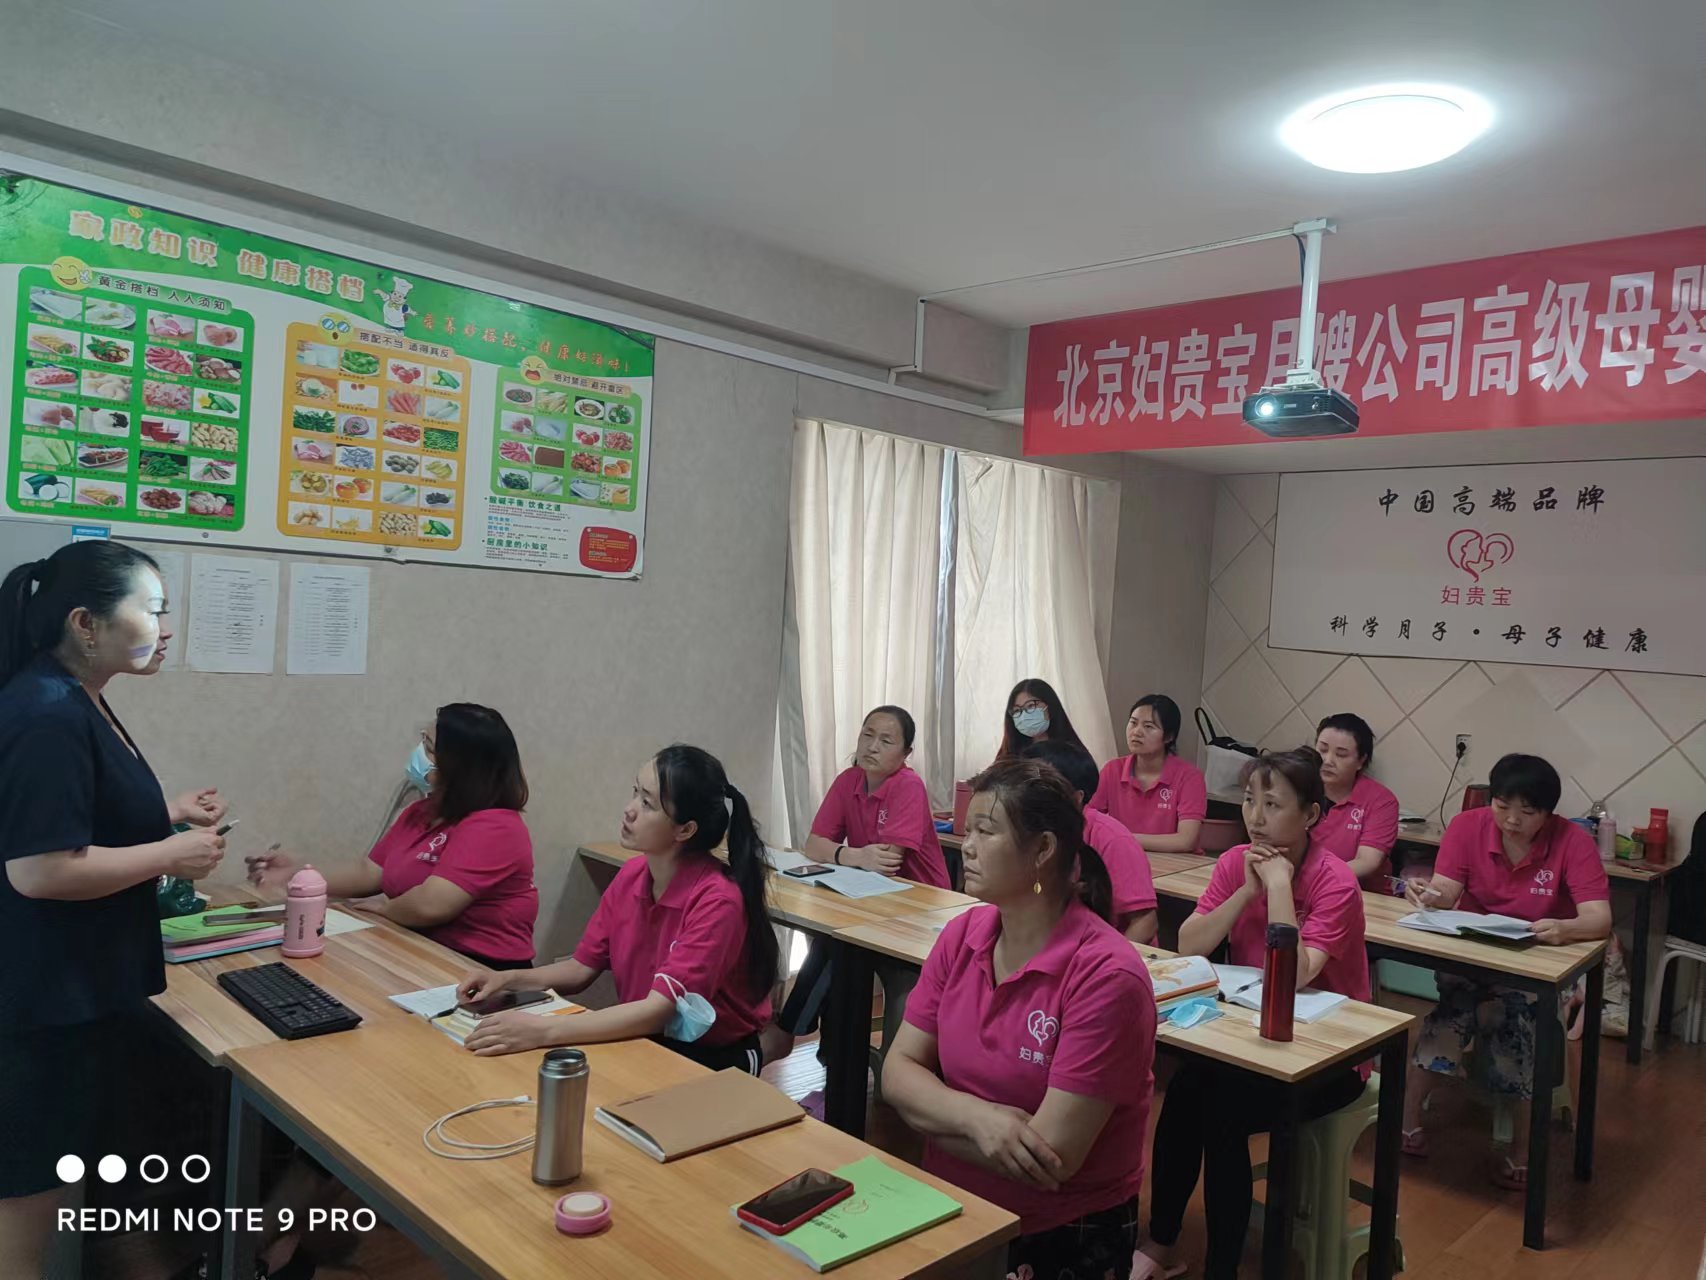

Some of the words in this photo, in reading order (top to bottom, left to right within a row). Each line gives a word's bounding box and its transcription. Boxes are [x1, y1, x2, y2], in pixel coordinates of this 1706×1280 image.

[69, 209, 218, 268] 家政知识
[236, 247, 366, 303] 健康搭档
[98, 275, 159, 298] 黄金搭档
[168, 290, 226, 312] 人人须知
[359, 332, 403, 349] 搭配不当
[408, 343, 449, 358] 适得其反
[528, 501, 561, 512] 饮食之道
[1378, 484, 1605, 518] 中国高端品牌
[1440, 585, 1512, 606] 妇贵宝
